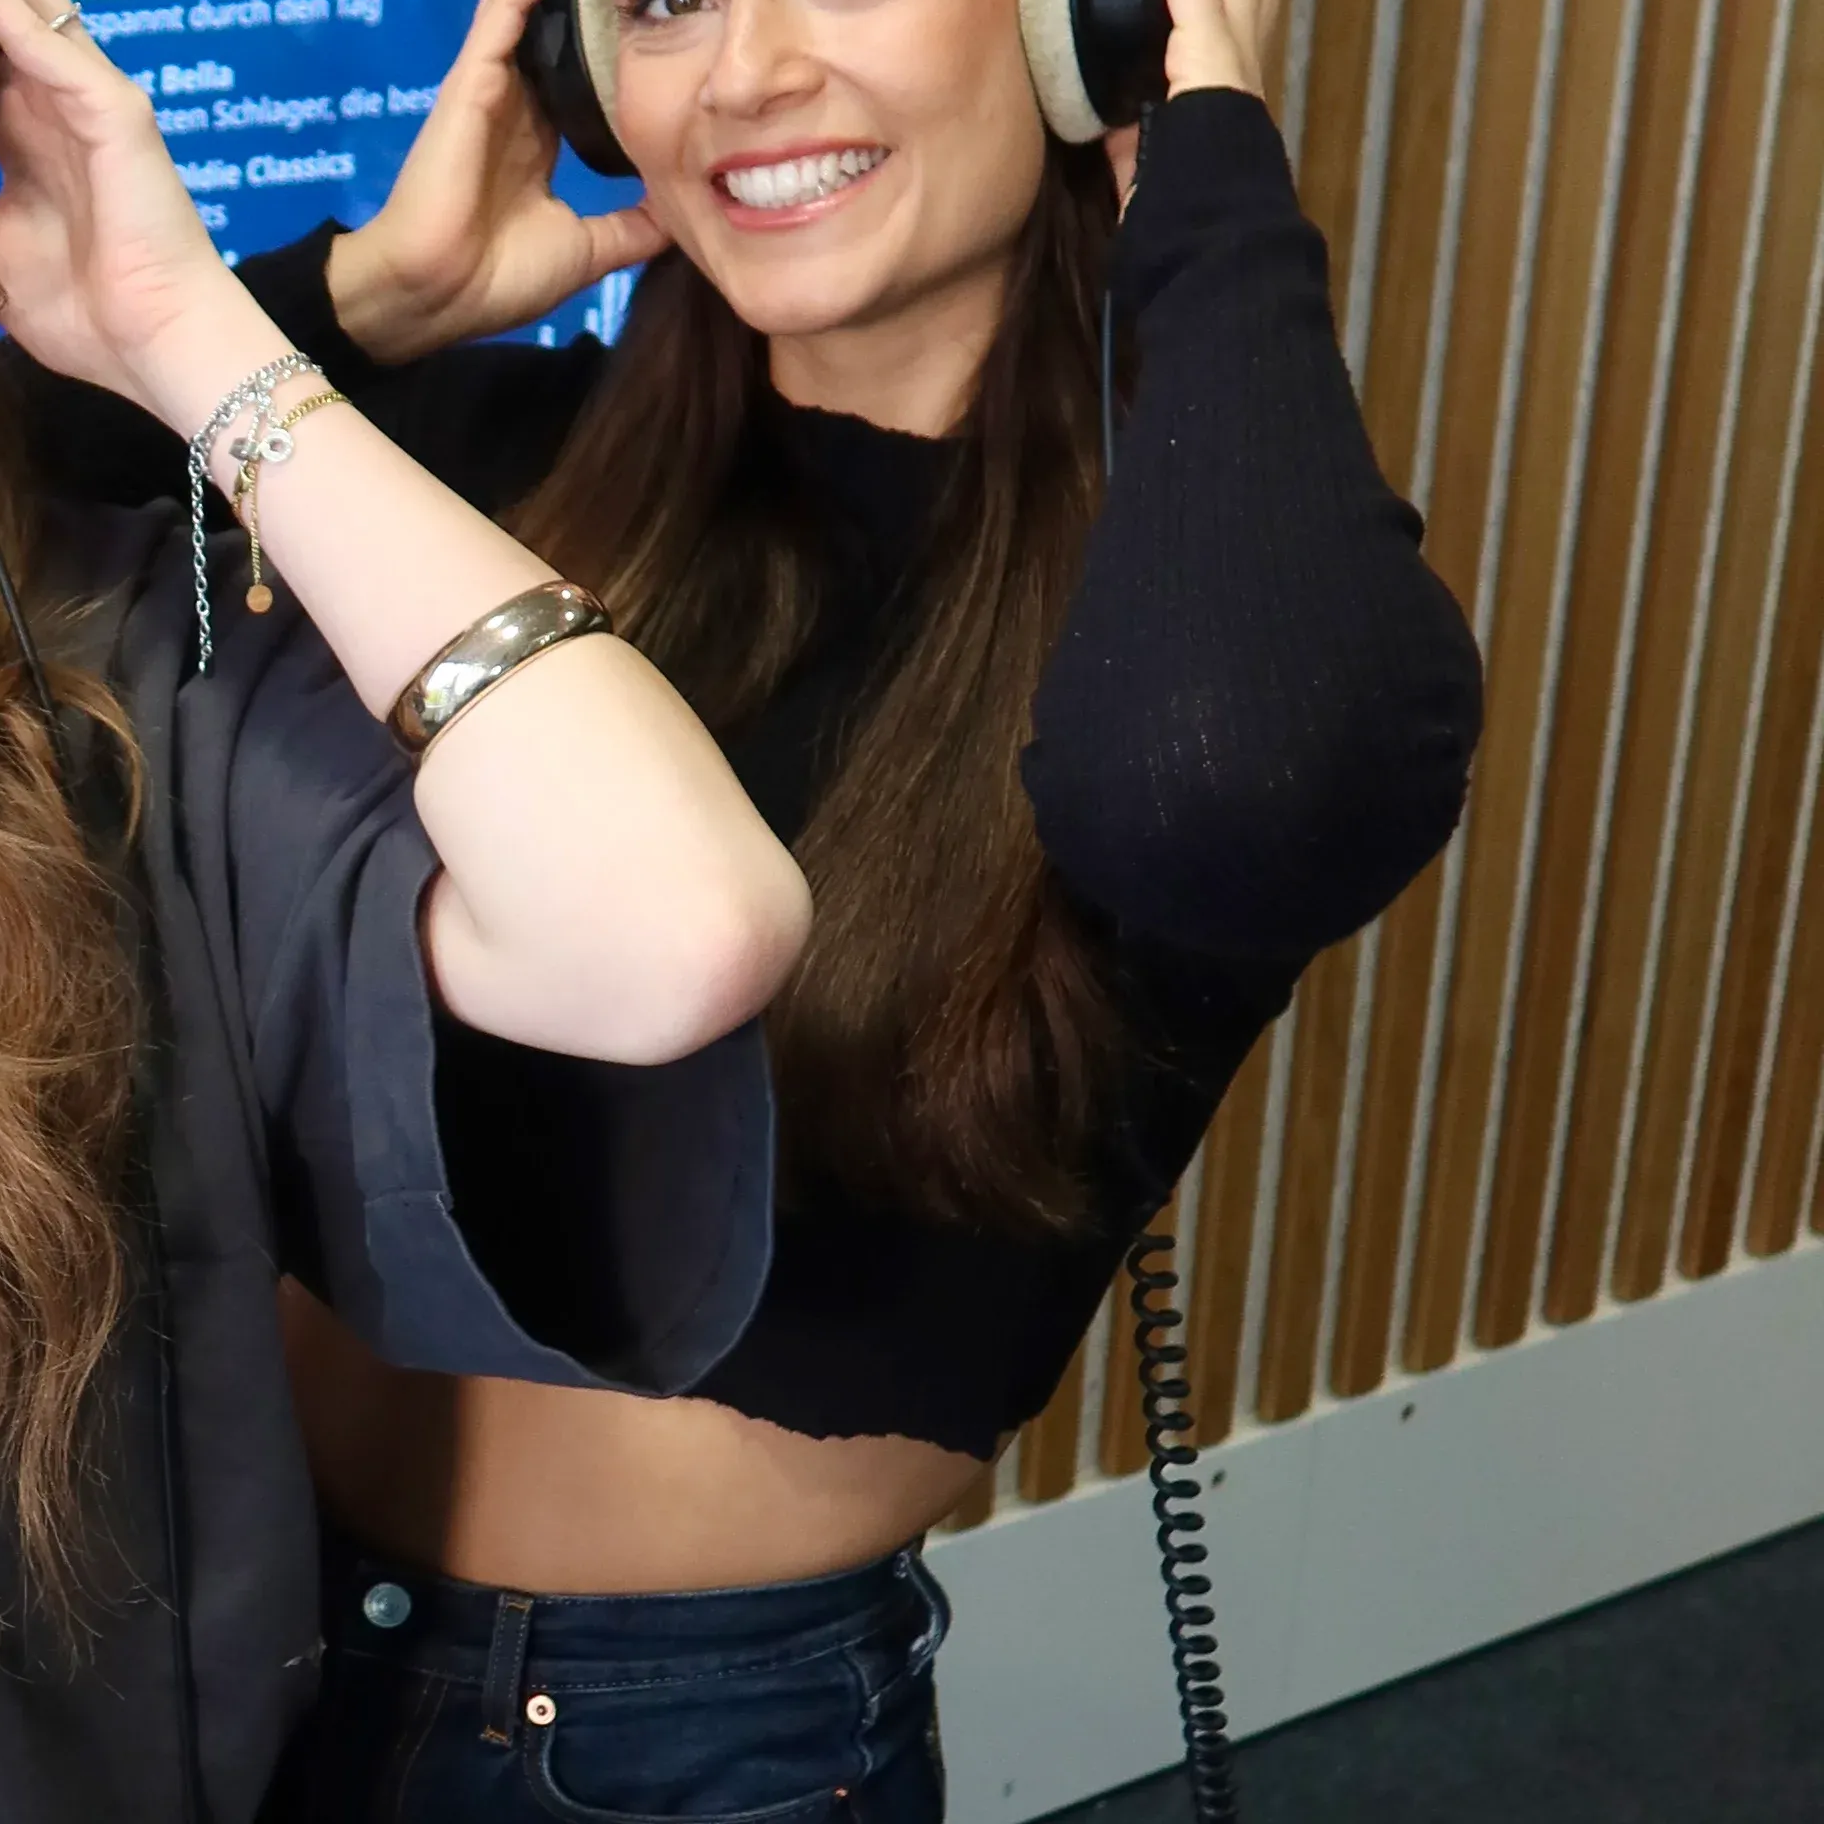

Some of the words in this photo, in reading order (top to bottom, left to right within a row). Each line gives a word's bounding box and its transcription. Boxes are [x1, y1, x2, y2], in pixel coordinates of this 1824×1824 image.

[160, 58, 236, 96] Bella
[212, 94, 337, 134] Schlager,
[338, 85, 385, 120] die
[245, 149, 356, 189] Classics
